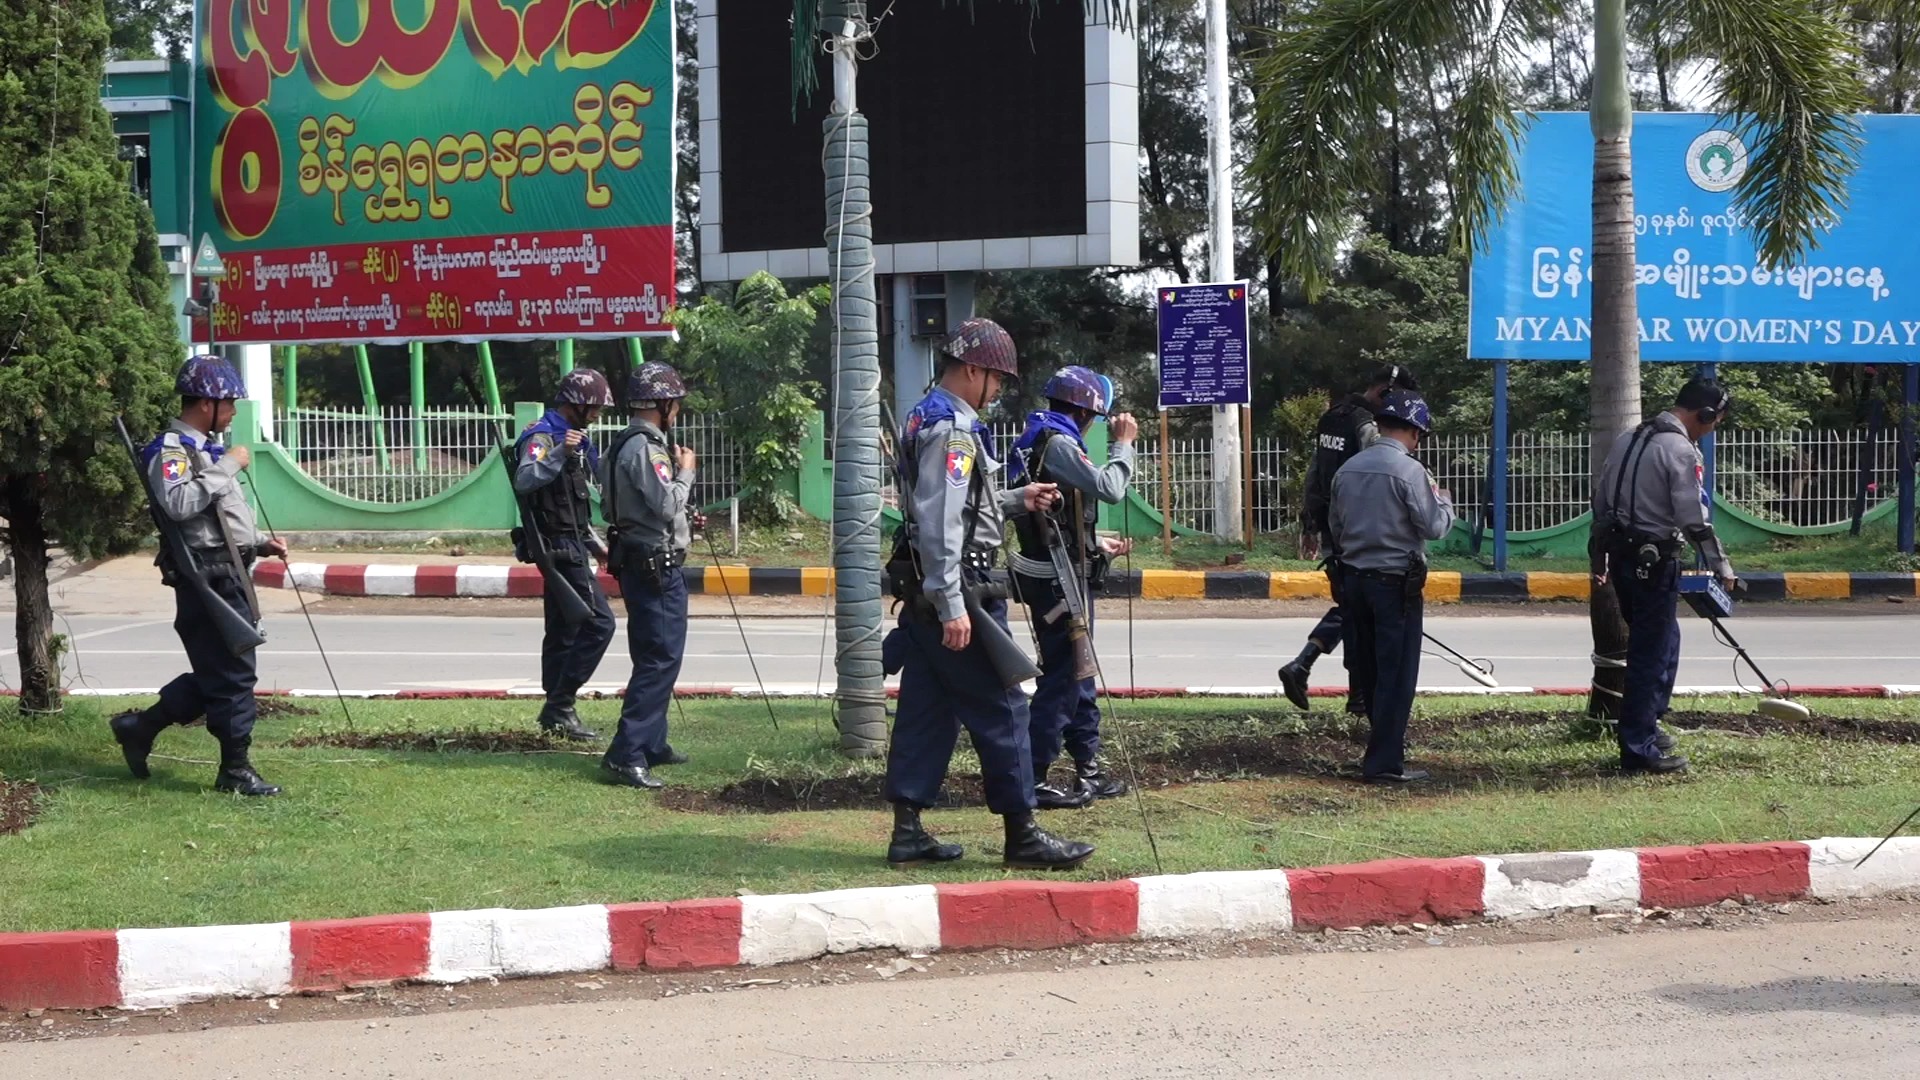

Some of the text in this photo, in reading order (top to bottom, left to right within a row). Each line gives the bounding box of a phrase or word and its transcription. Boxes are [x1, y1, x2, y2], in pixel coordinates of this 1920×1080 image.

[1495, 316, 1674, 342] MYANAR
[1852, 320, 1920, 346] DAY
[1319, 433, 1346, 451] POLICE
